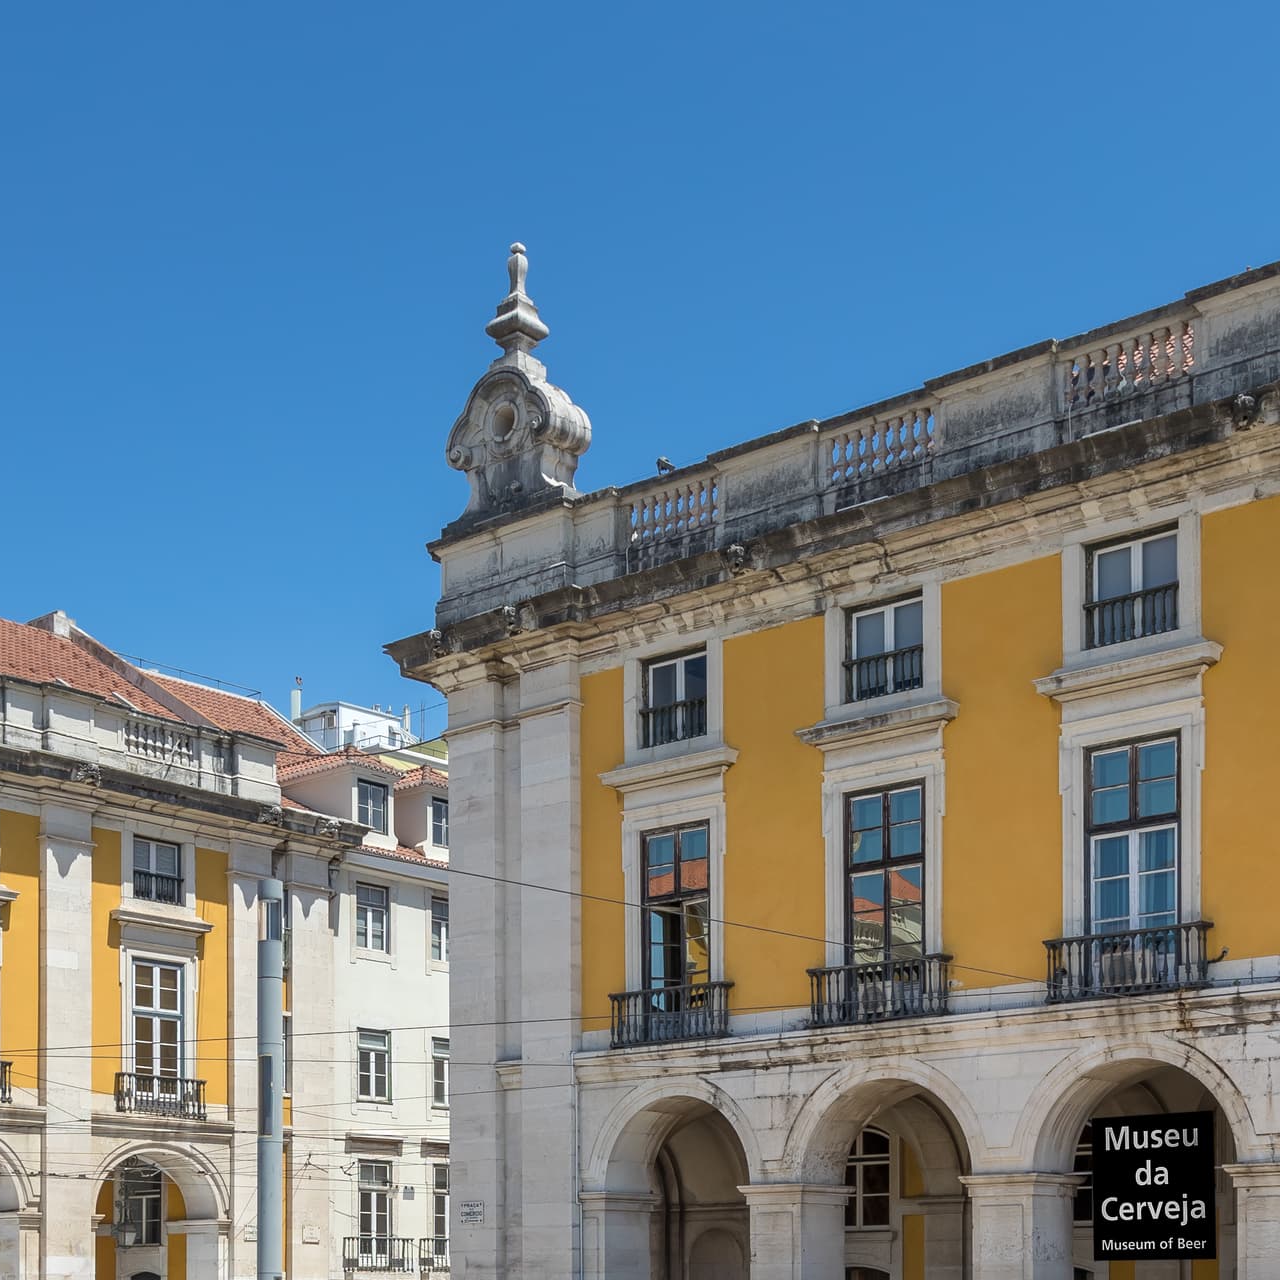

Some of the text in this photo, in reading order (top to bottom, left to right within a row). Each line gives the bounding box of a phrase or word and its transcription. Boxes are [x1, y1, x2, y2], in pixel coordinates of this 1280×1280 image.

[1105, 1126, 1199, 1151] Museu
[1135, 1160, 1169, 1186] da
[1101, 1194, 1206, 1226] Cerveja
[1102, 1237, 1207, 1251] Museum of Beer
